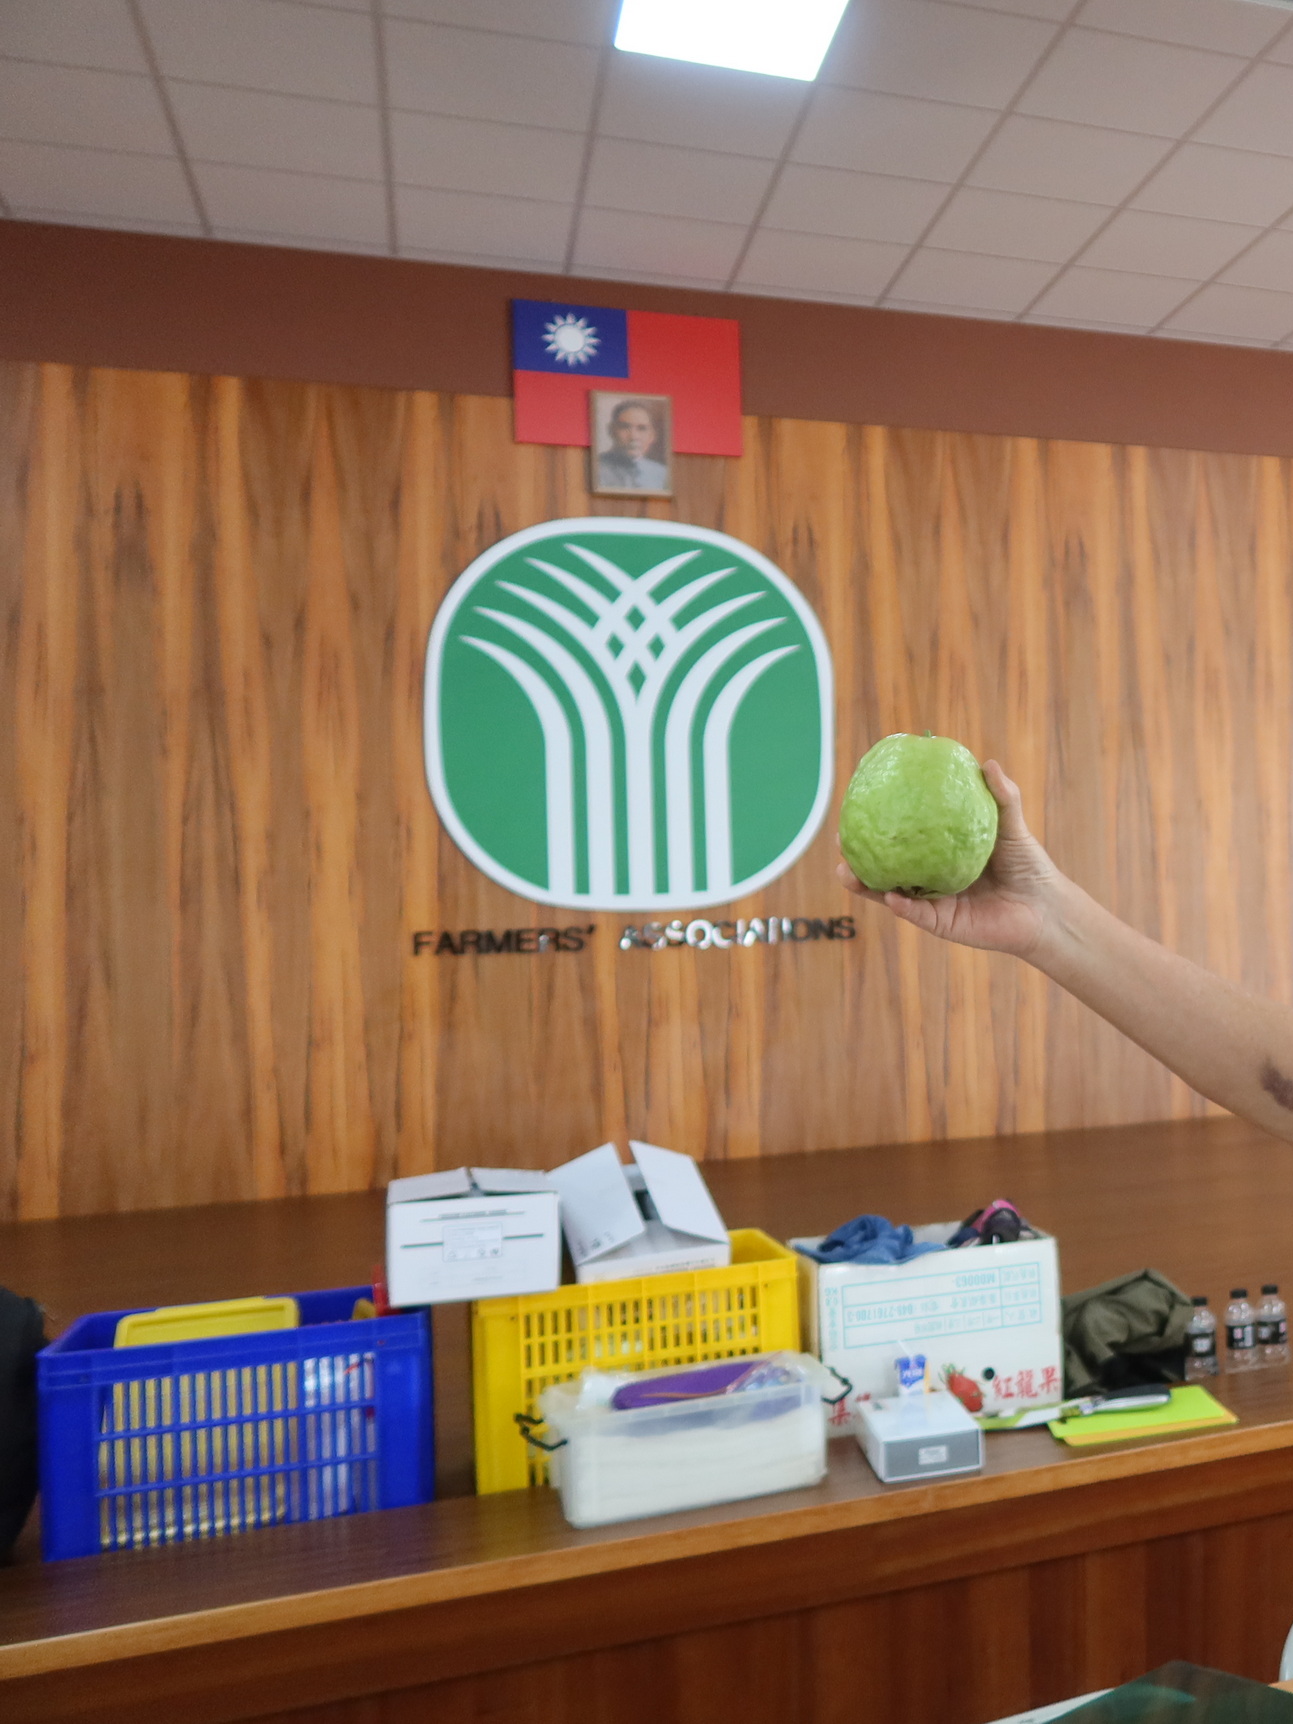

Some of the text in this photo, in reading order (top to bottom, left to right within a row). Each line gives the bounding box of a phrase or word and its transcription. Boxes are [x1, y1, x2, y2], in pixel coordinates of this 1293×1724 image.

[619, 916, 856, 950] ASSOCIATIONS
[993, 1366, 1062, 1400] 紅龍果
